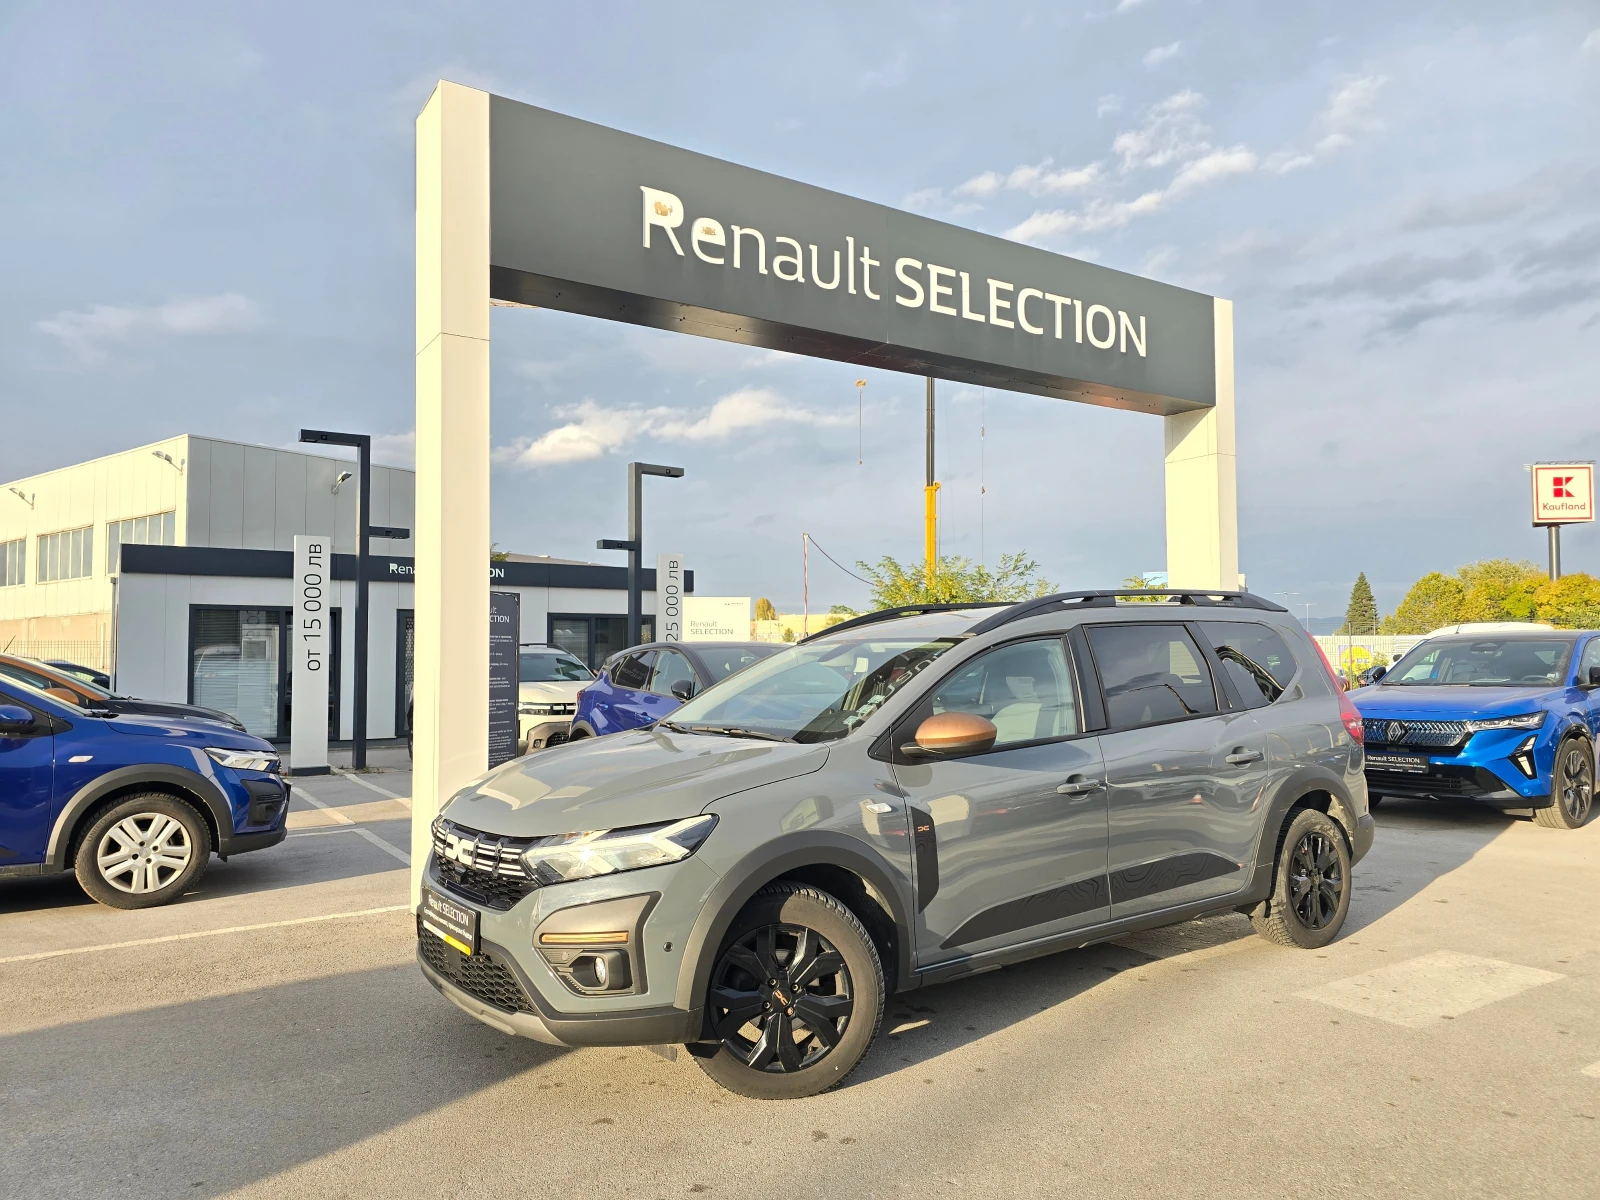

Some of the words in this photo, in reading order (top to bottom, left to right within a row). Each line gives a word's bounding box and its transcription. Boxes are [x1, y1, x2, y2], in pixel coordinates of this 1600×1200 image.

[640, 185, 881, 301] Renault
[895, 257, 1147, 358] SELECTION
[1542, 502, 1586, 511] Kaufland
[303, 573, 321, 612] 000
[665, 585, 679, 616] 000
[303, 618, 321, 641] 15
[690, 620, 719, 628] Renault
[442, 903, 469, 926] SELECTION
